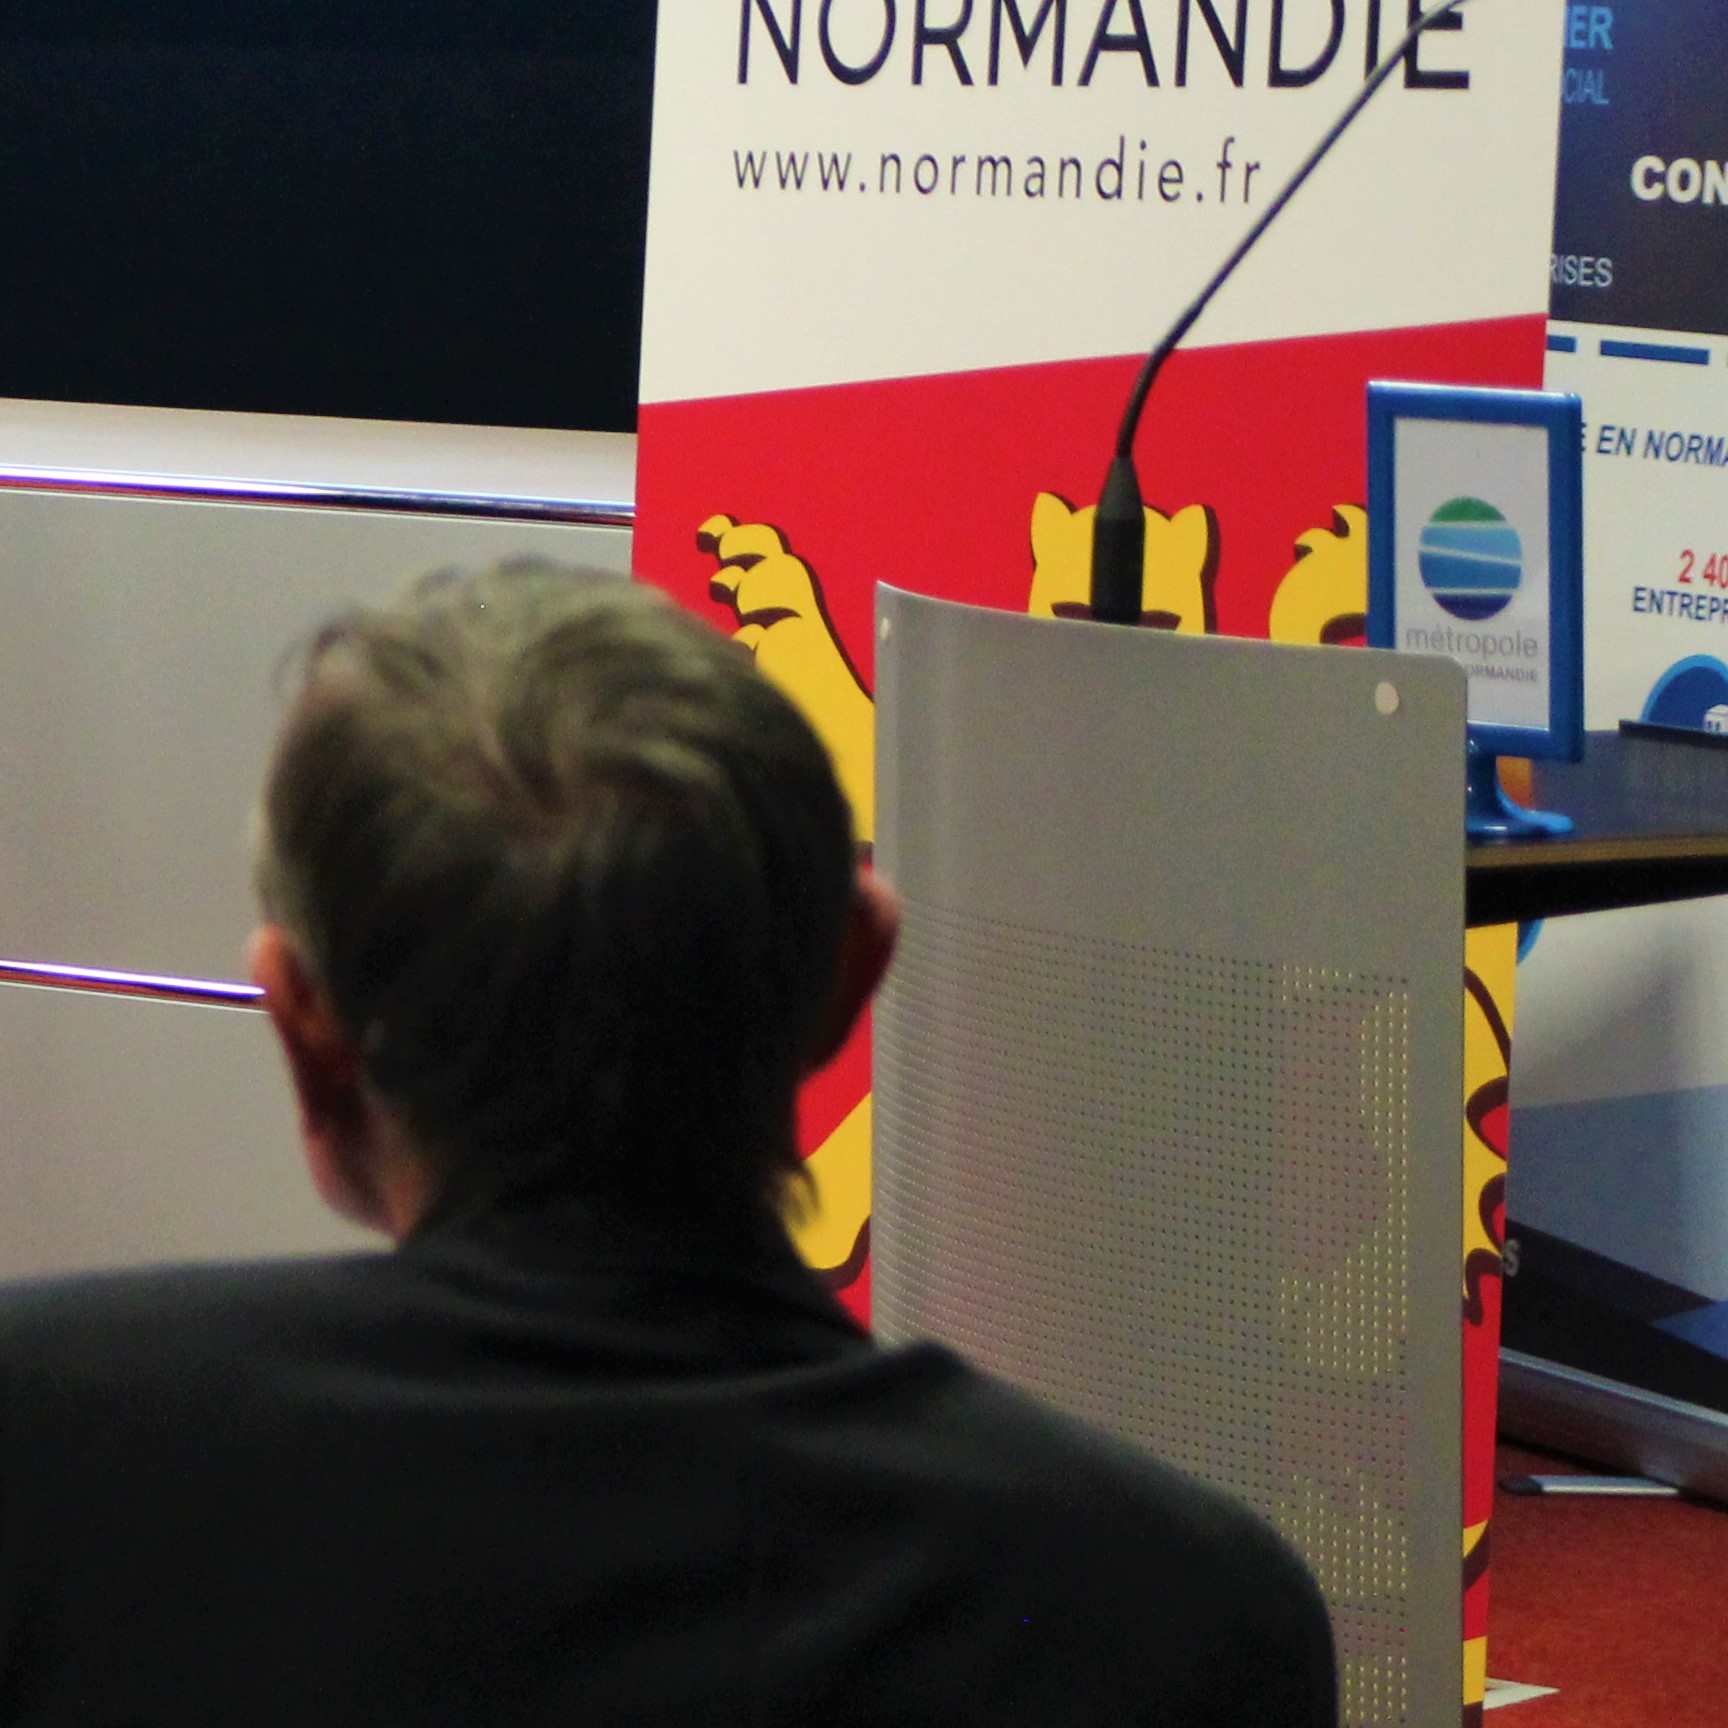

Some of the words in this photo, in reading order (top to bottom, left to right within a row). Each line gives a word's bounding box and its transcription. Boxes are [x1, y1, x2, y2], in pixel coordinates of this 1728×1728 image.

[732, 134, 1262, 204] www.normandie.fr
[1595, 424, 1638, 457] EN
[1643, 428, 1728, 467] NORM
[1678, 549, 1695, 584] 2
[1405, 623, 1539, 659] métropole
